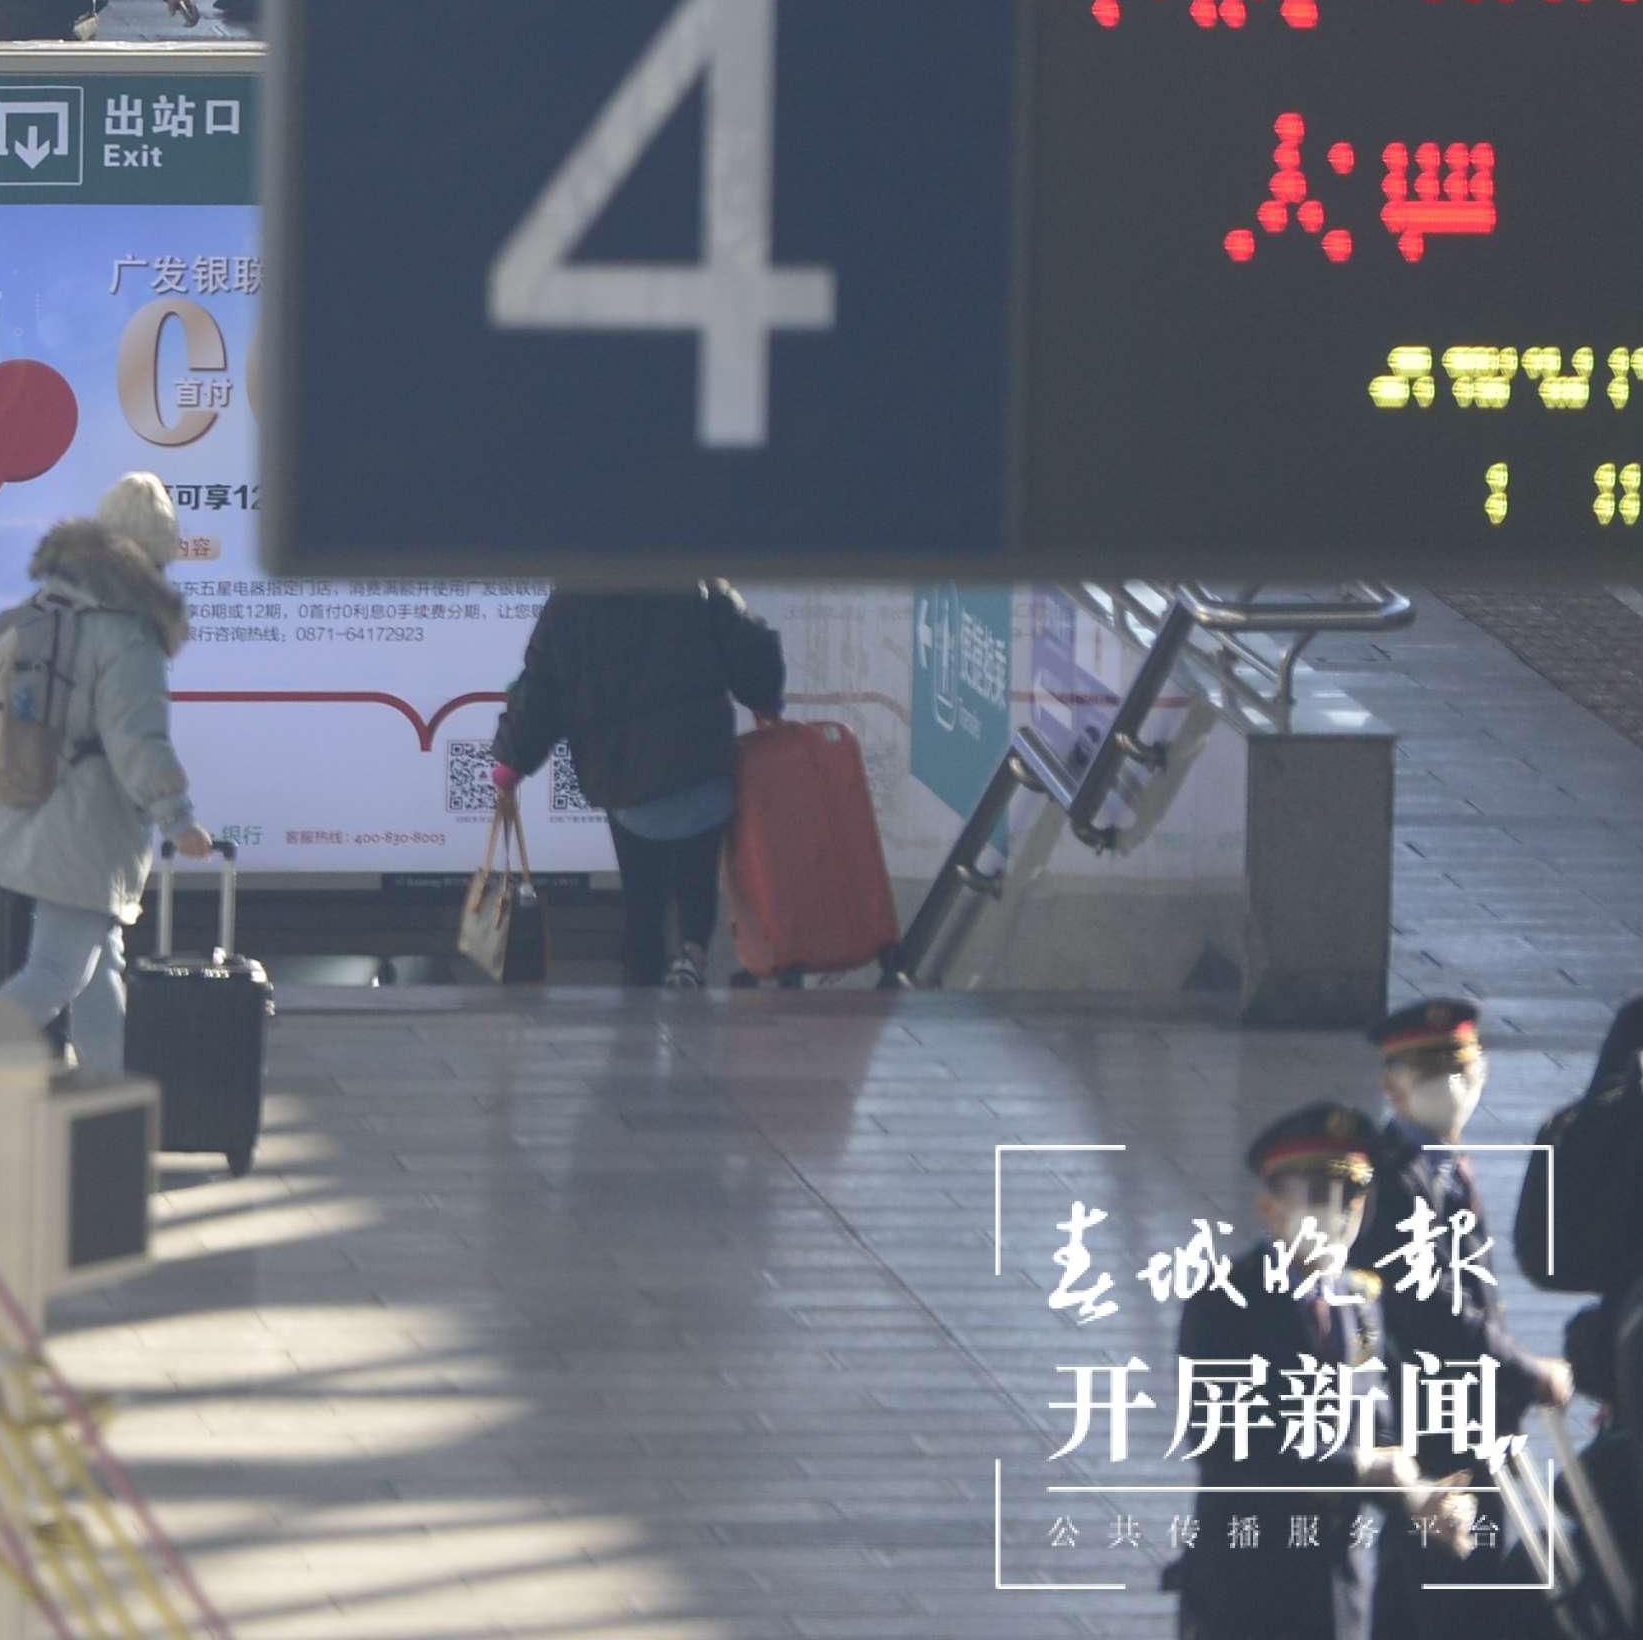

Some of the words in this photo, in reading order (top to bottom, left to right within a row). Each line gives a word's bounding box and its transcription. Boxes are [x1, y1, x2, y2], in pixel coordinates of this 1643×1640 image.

[104, 94, 241, 138] 出站口
[103, 144, 163, 168] Exit
[174, 377, 233, 410] 首付
